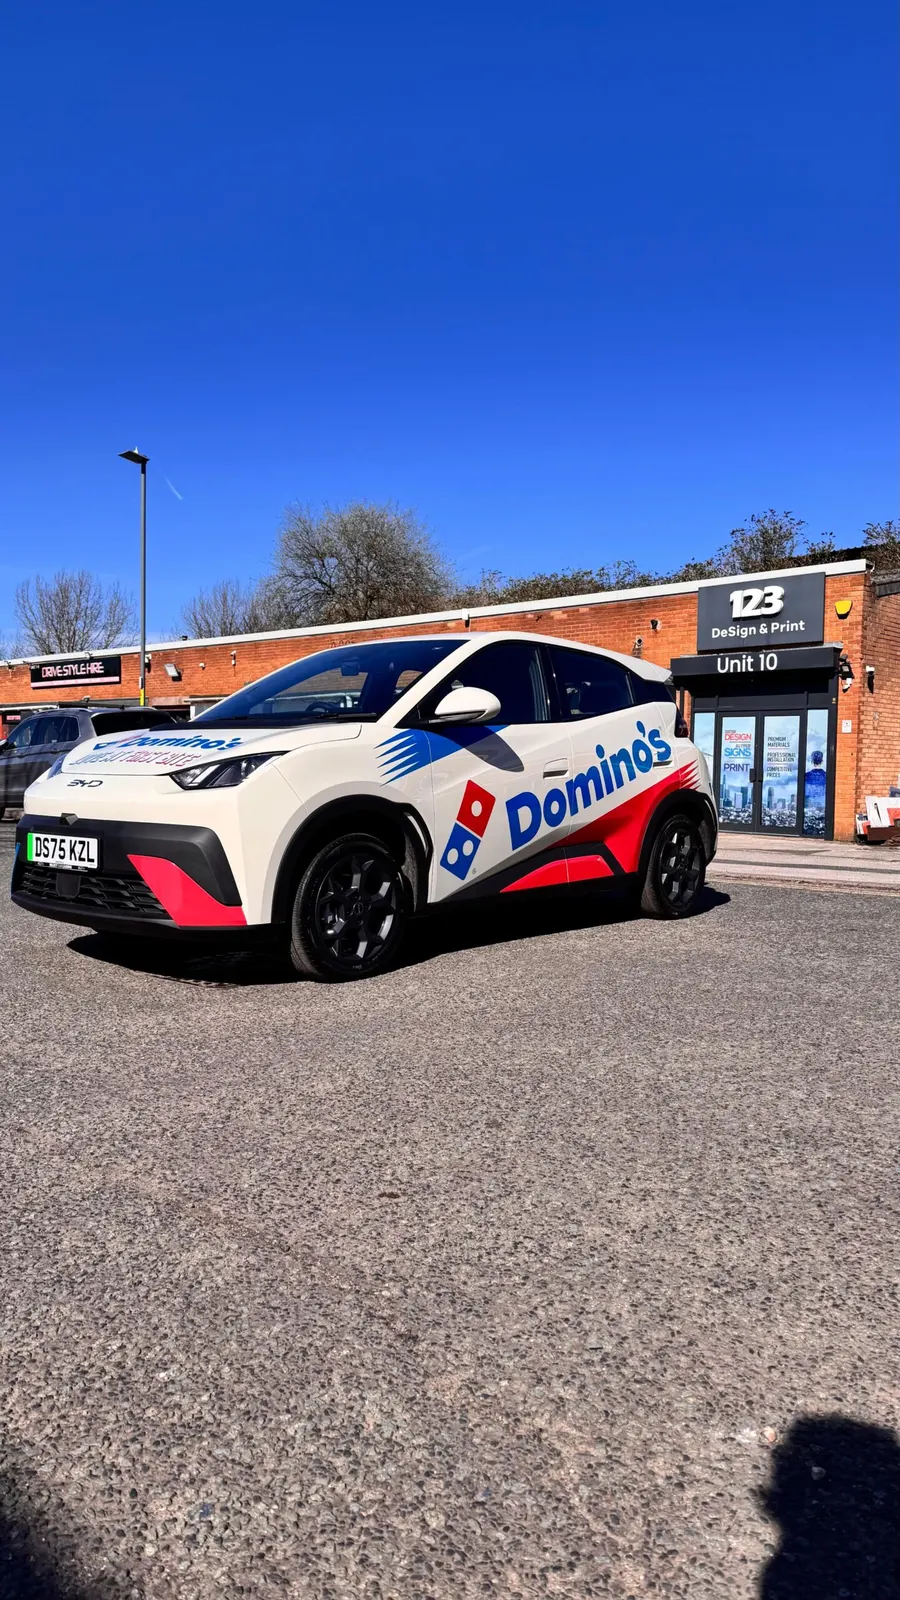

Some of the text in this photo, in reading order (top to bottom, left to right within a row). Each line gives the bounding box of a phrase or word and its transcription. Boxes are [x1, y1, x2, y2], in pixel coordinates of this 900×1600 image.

[730, 585, 785, 619] 123
[712, 620, 805, 639] DeSign & Print
[717, 653, 778, 674] Unit 10
[118, 735, 244, 751] Domino's
[724, 733, 752, 741] DESIGN
[724, 747, 752, 757] SIGNS
[723, 763, 750, 772] PRINT
[67, 779, 103, 788] BYD
[505, 720, 672, 851] Domino's
[35, 836, 95, 863] DS75 KZL
